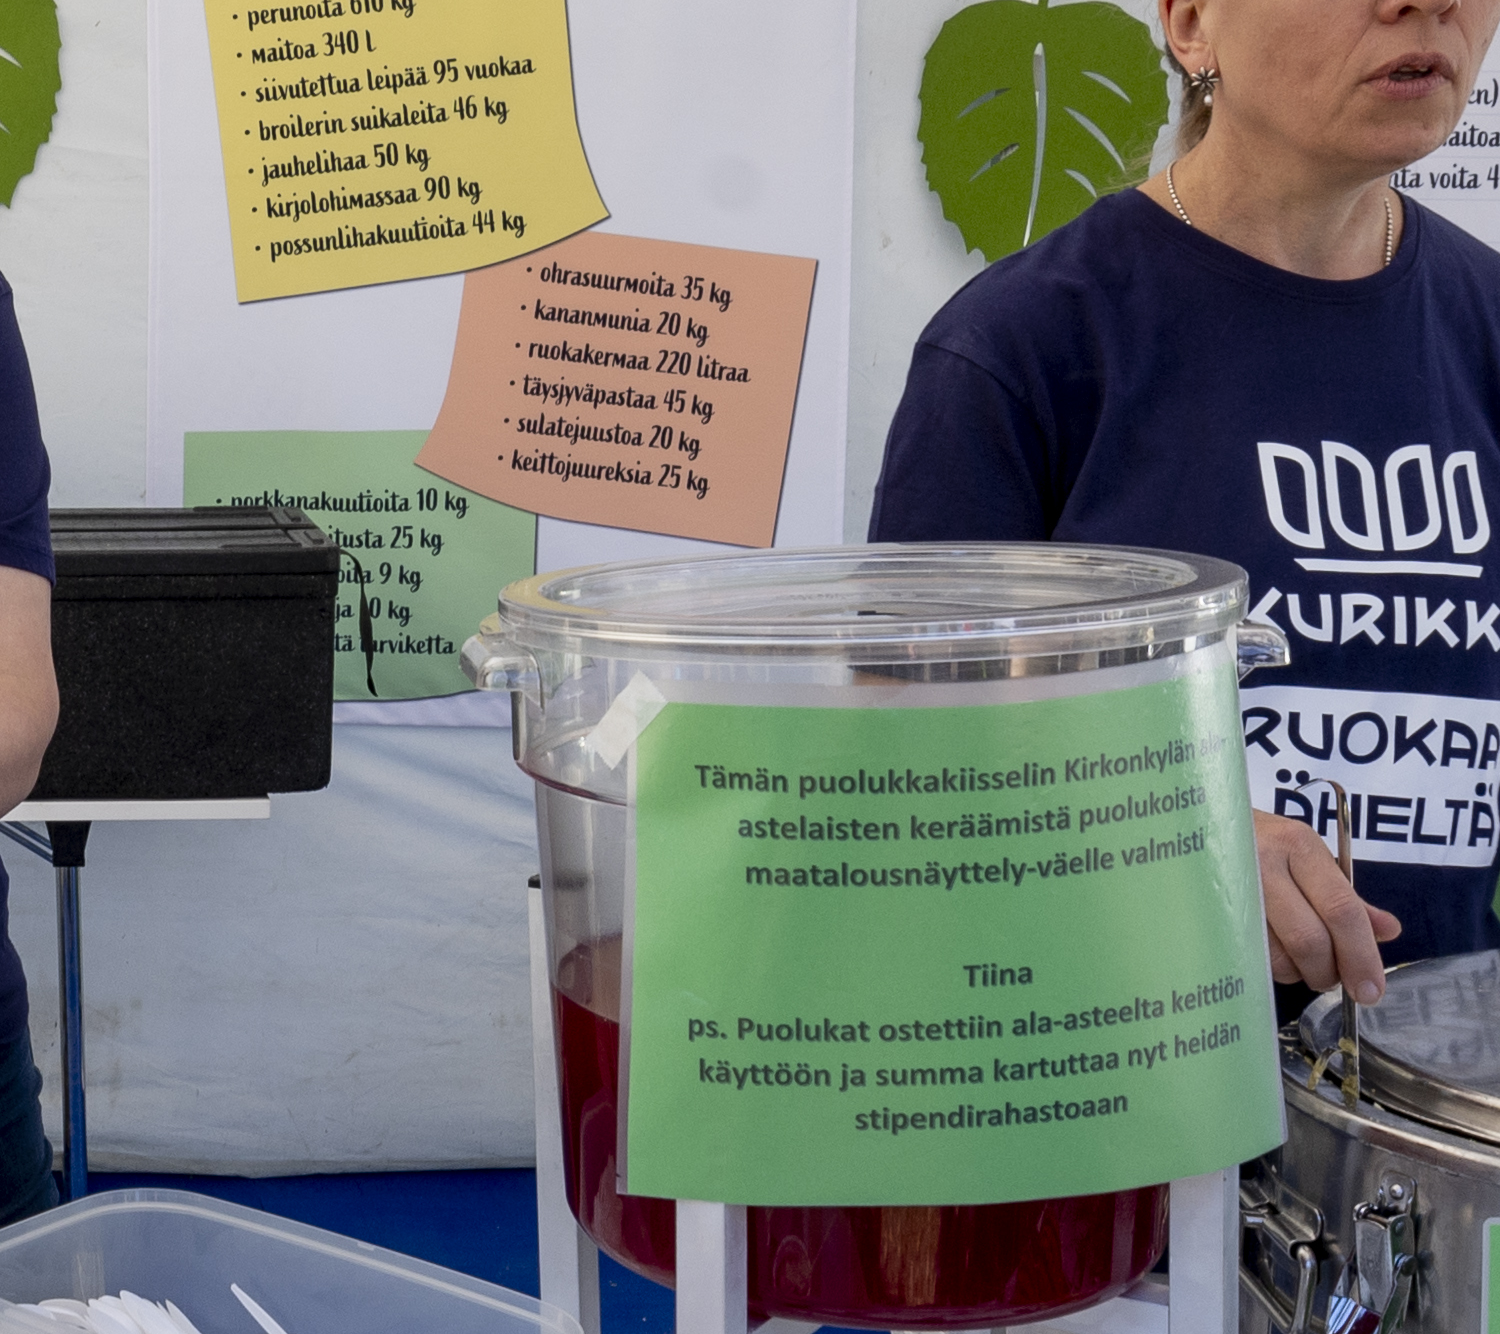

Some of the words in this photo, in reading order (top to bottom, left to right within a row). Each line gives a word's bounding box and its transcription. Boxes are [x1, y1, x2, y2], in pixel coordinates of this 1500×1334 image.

[251, 37, 319, 64] maitoa
[322, 29, 360, 57] 340
[255, 72, 364, 103] siivutettua
[366, 65, 430, 95] leipää
[433, 57, 459, 85] 95
[464, 55, 537, 81] vuokaa
[258, 110, 348, 142] broilerin
[350, 100, 450, 132] suikaleita
[453, 94, 478, 121] 46
[483, 96, 510, 125] kg
[261, 149, 370, 188] jauhelihaa
[373, 141, 399, 169] 50
[405, 143, 431, 173] kg
[1429, 163, 1482, 190] voita
[1486, 163, 1500, 190] 4
[266, 186, 421, 223] kirjolohimassaa
[423, 175, 451, 202] 90
[457, 176, 483, 206] kg
[270, 214, 469, 263] possunlihakuutioita
[472, 208, 496, 235] 44
[501, 210, 527, 239] kg
[540, 261, 676, 298] ohrasuurmoita
[680, 275, 705, 302] 35
[709, 281, 732, 313] kg
[534, 298, 652, 333] kananmunia
[655, 310, 682, 337] 20
[685, 317, 710, 349] kg
[528, 340, 652, 371] ruokakermaa
[655, 349, 692, 376] 220
[696, 354, 752, 383] litraa
[523, 373, 659, 410] täysjyväpastaa
[663, 388, 687, 414] 45
[690, 394, 715, 425] kg
[516, 412, 645, 447] sulatejuustoa
[648, 424, 674, 450] 20
[678, 430, 702, 462] kg
[511, 448, 654, 486] keittojuureksia
[657, 463, 682, 489] 25
[686, 469, 711, 501] kg
[416, 487, 438, 512] 10
[444, 490, 470, 520] kg
[389, 525, 414, 549] 25
[419, 527, 445, 557] kg
[379, 561, 392, 585] 9
[398, 564, 424, 594] kg
[369, 597, 381, 619] 0
[387, 599, 413, 628] kg
[1242, 707, 1500, 769] RUOKAA
[694, 764, 789, 794] Tämän
[799, 762, 1056, 800] puolukkakiisselin
[1064, 738, 1196, 784] Kirkonkylän
[738, 814, 901, 842] astelaisten
[910, 805, 1071, 840] keräämistä
[1078, 785, 1204, 835] puolukoista
[1274, 768, 1496, 847] ÄHELTÄ
[745, 847, 1114, 892] maatalousnäyttely-väelle
[1120, 826, 1205, 867] valmisti
[962, 962, 1033, 988] Tiina
[688, 1018, 728, 1043] ps.
[737, 1017, 871, 1043] Puolukat
[878, 1014, 1004, 1043] ostettiin
[1011, 997, 1164, 1037] ala-asteelta
[1171, 974, 1245, 1015] keittiön
[699, 1057, 832, 1091] käyttöön
[838, 1062, 867, 1093] ja
[875, 1065, 985, 1087] summa
[993, 1052, 1120, 1083] kartuttaa
[1127, 1040, 1168, 1070] nyt
[1174, 1021, 1241, 1059] heidän
[854, 1095, 1128, 1136] stipendirahastoaan
